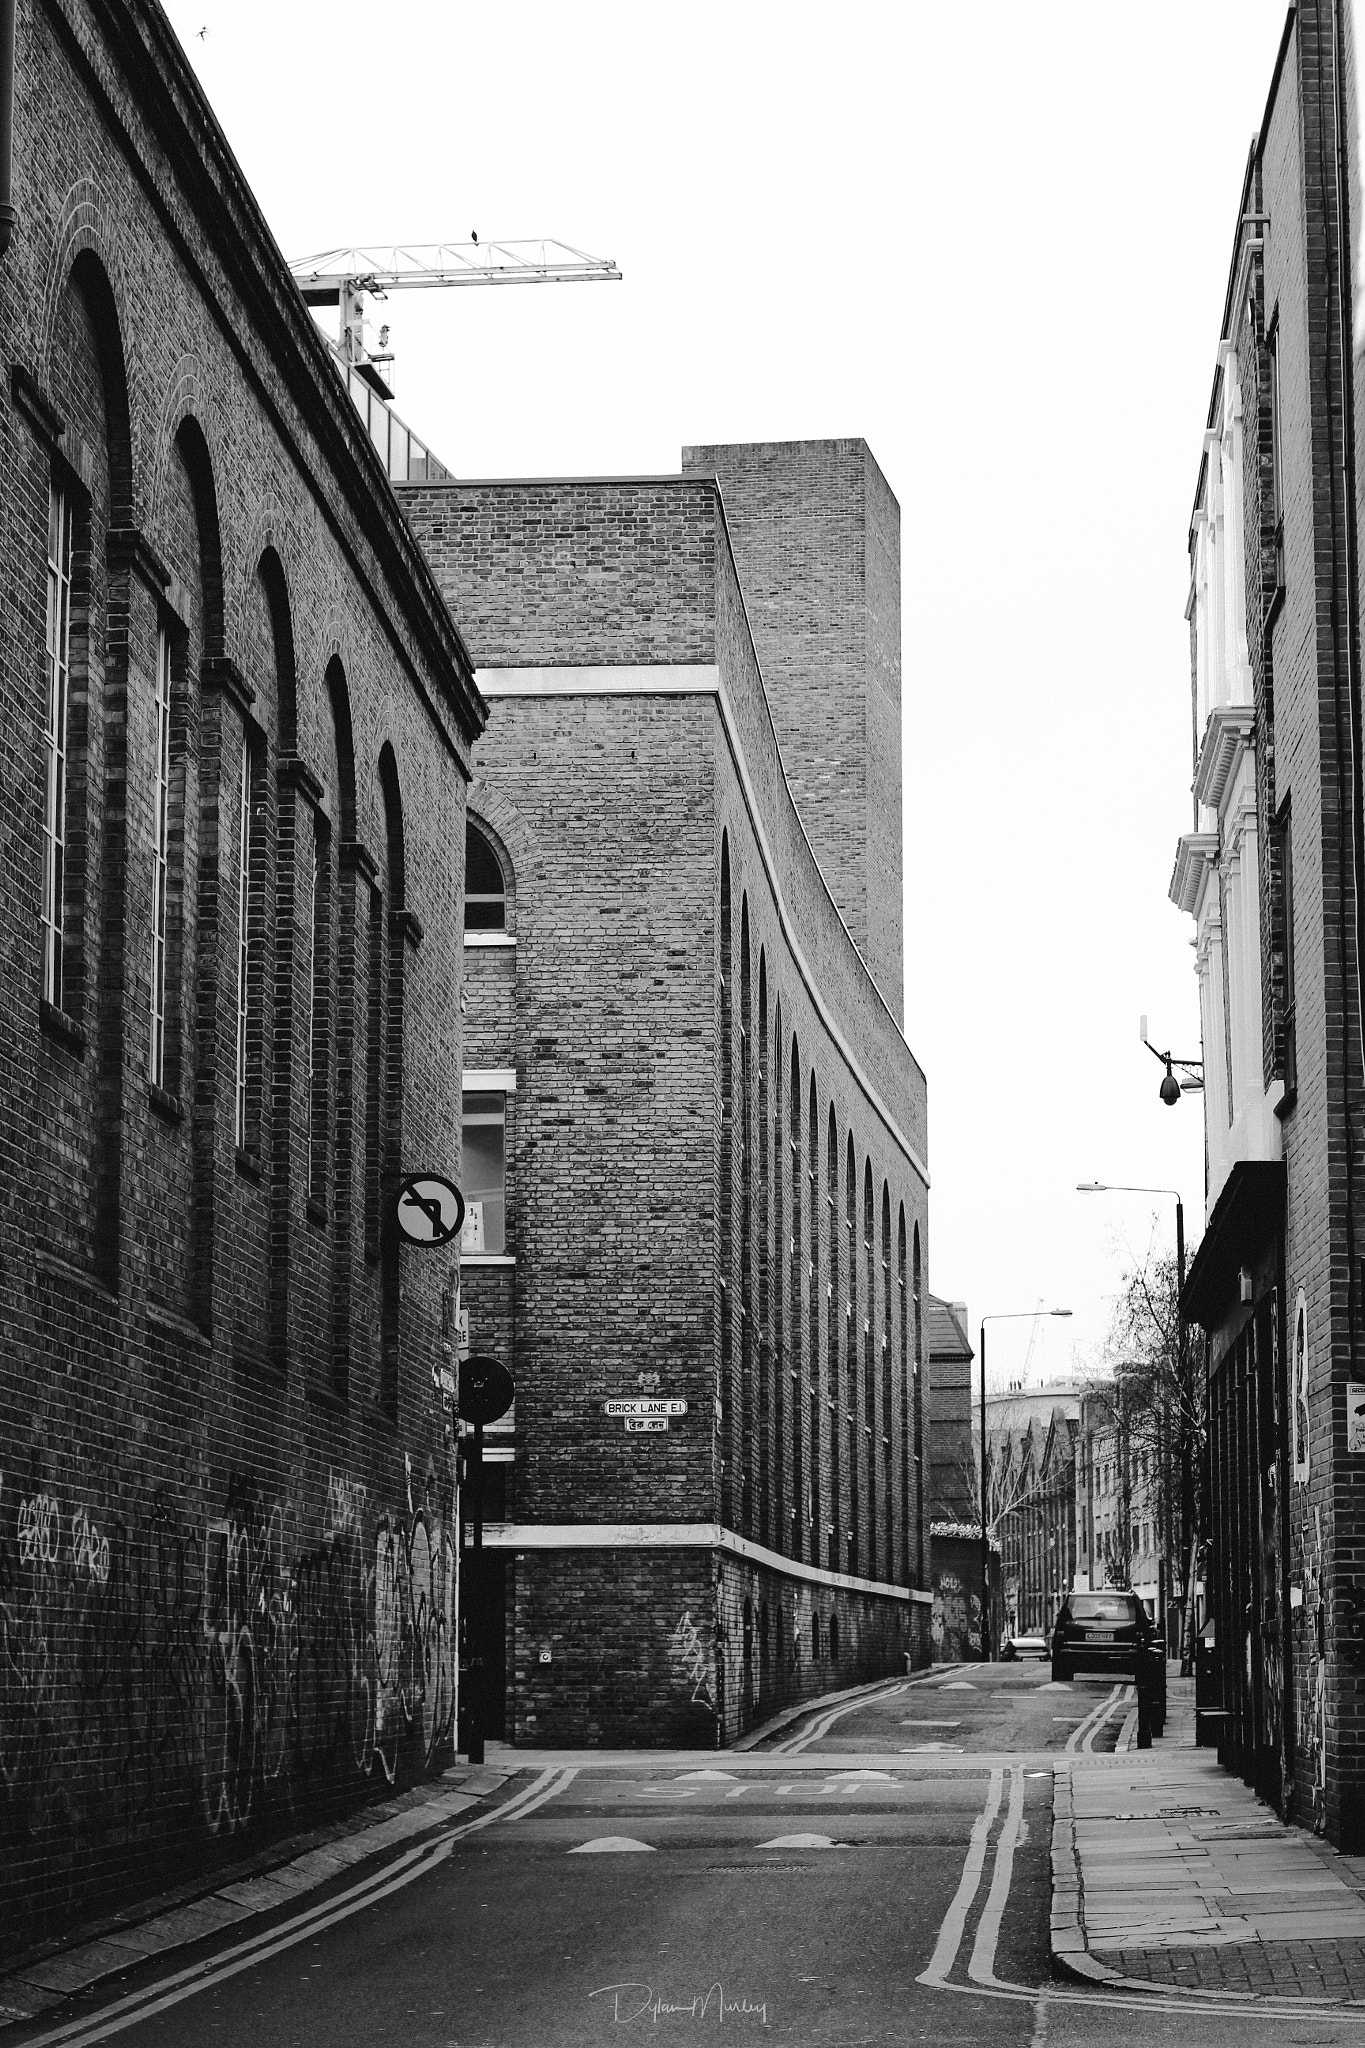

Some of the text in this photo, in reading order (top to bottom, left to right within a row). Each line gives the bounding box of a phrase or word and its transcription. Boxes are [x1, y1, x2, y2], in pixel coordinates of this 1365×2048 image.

[608, 1403, 637, 1413] BRICK
[641, 1403, 667, 1413] LANE
[635, 1783, 904, 1798] STOP
